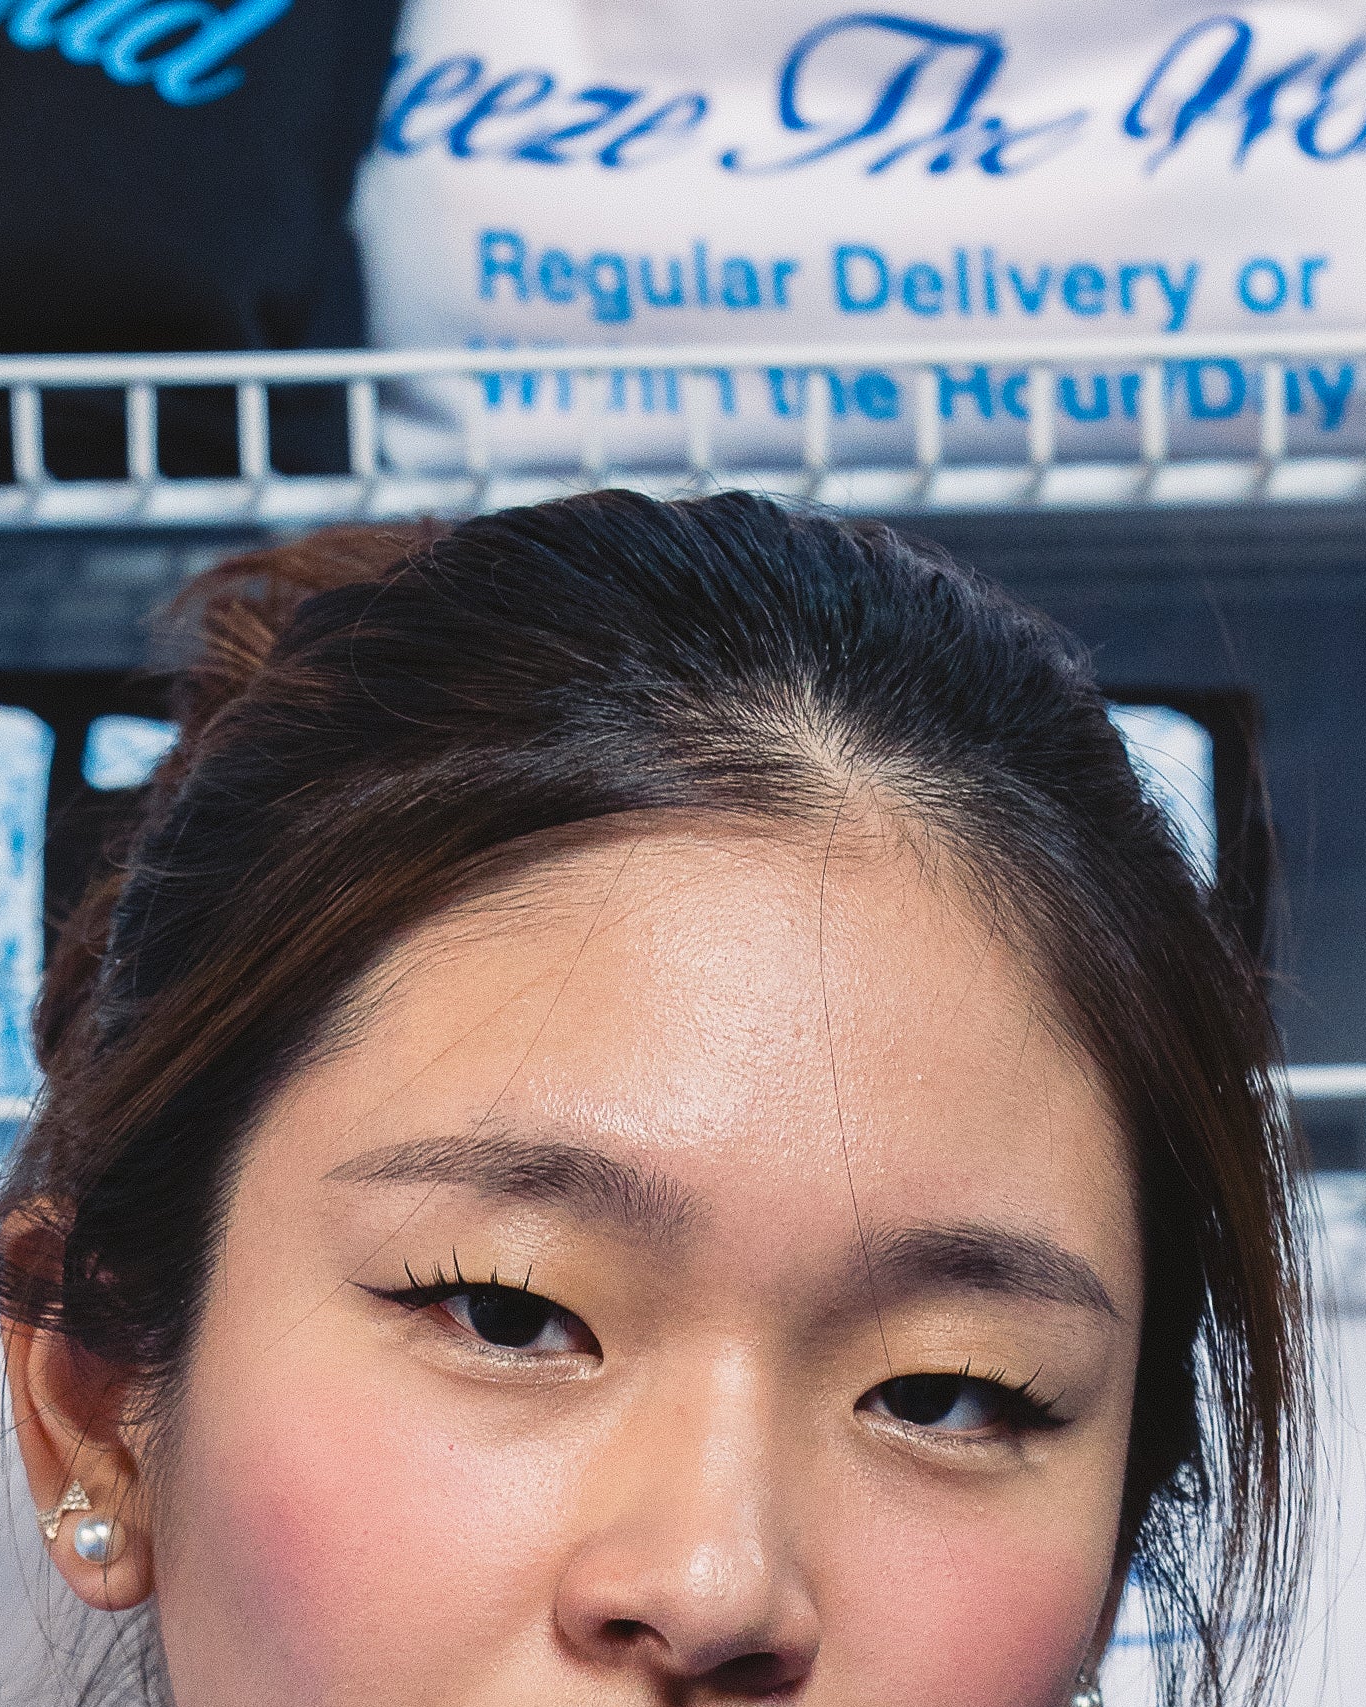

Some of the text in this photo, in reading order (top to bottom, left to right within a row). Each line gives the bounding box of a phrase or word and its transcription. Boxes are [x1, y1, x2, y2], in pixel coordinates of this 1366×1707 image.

[385, 50, 709, 170] eeze
[718, 12, 1090, 176] The
[477, 226, 1328, 333] Regular Delivery or
